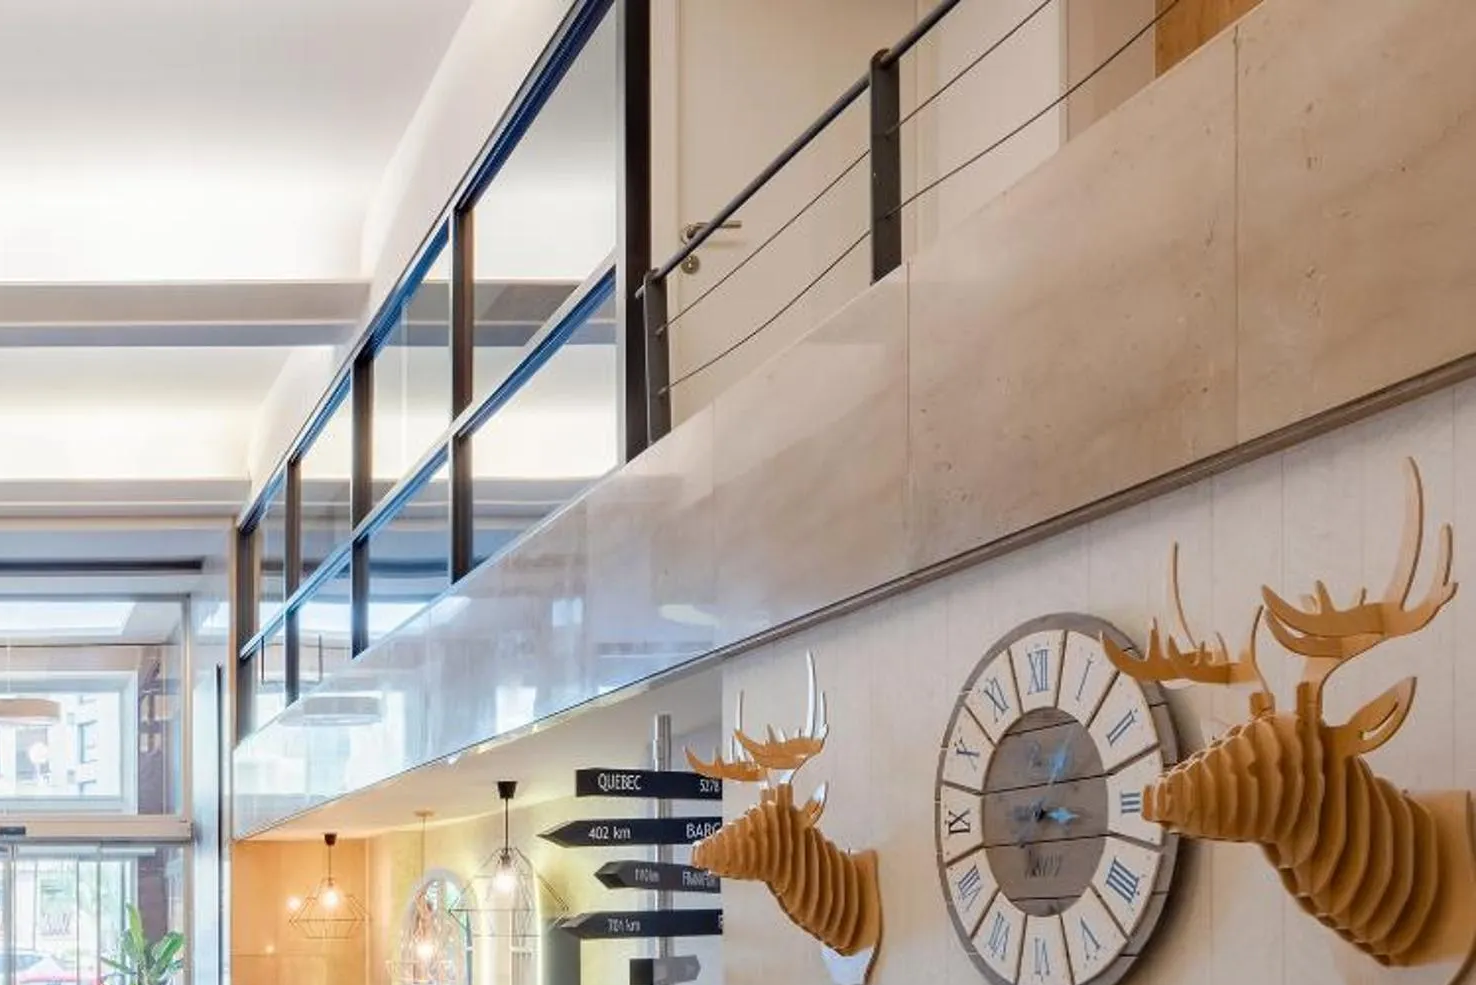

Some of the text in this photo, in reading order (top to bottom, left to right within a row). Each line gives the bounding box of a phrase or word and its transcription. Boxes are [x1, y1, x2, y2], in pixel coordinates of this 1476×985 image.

[1026, 648, 1050, 695] XII
[597, 773, 642, 792] QUEBEC
[588, 826, 610, 840] 402
[613, 825, 632, 839] km
